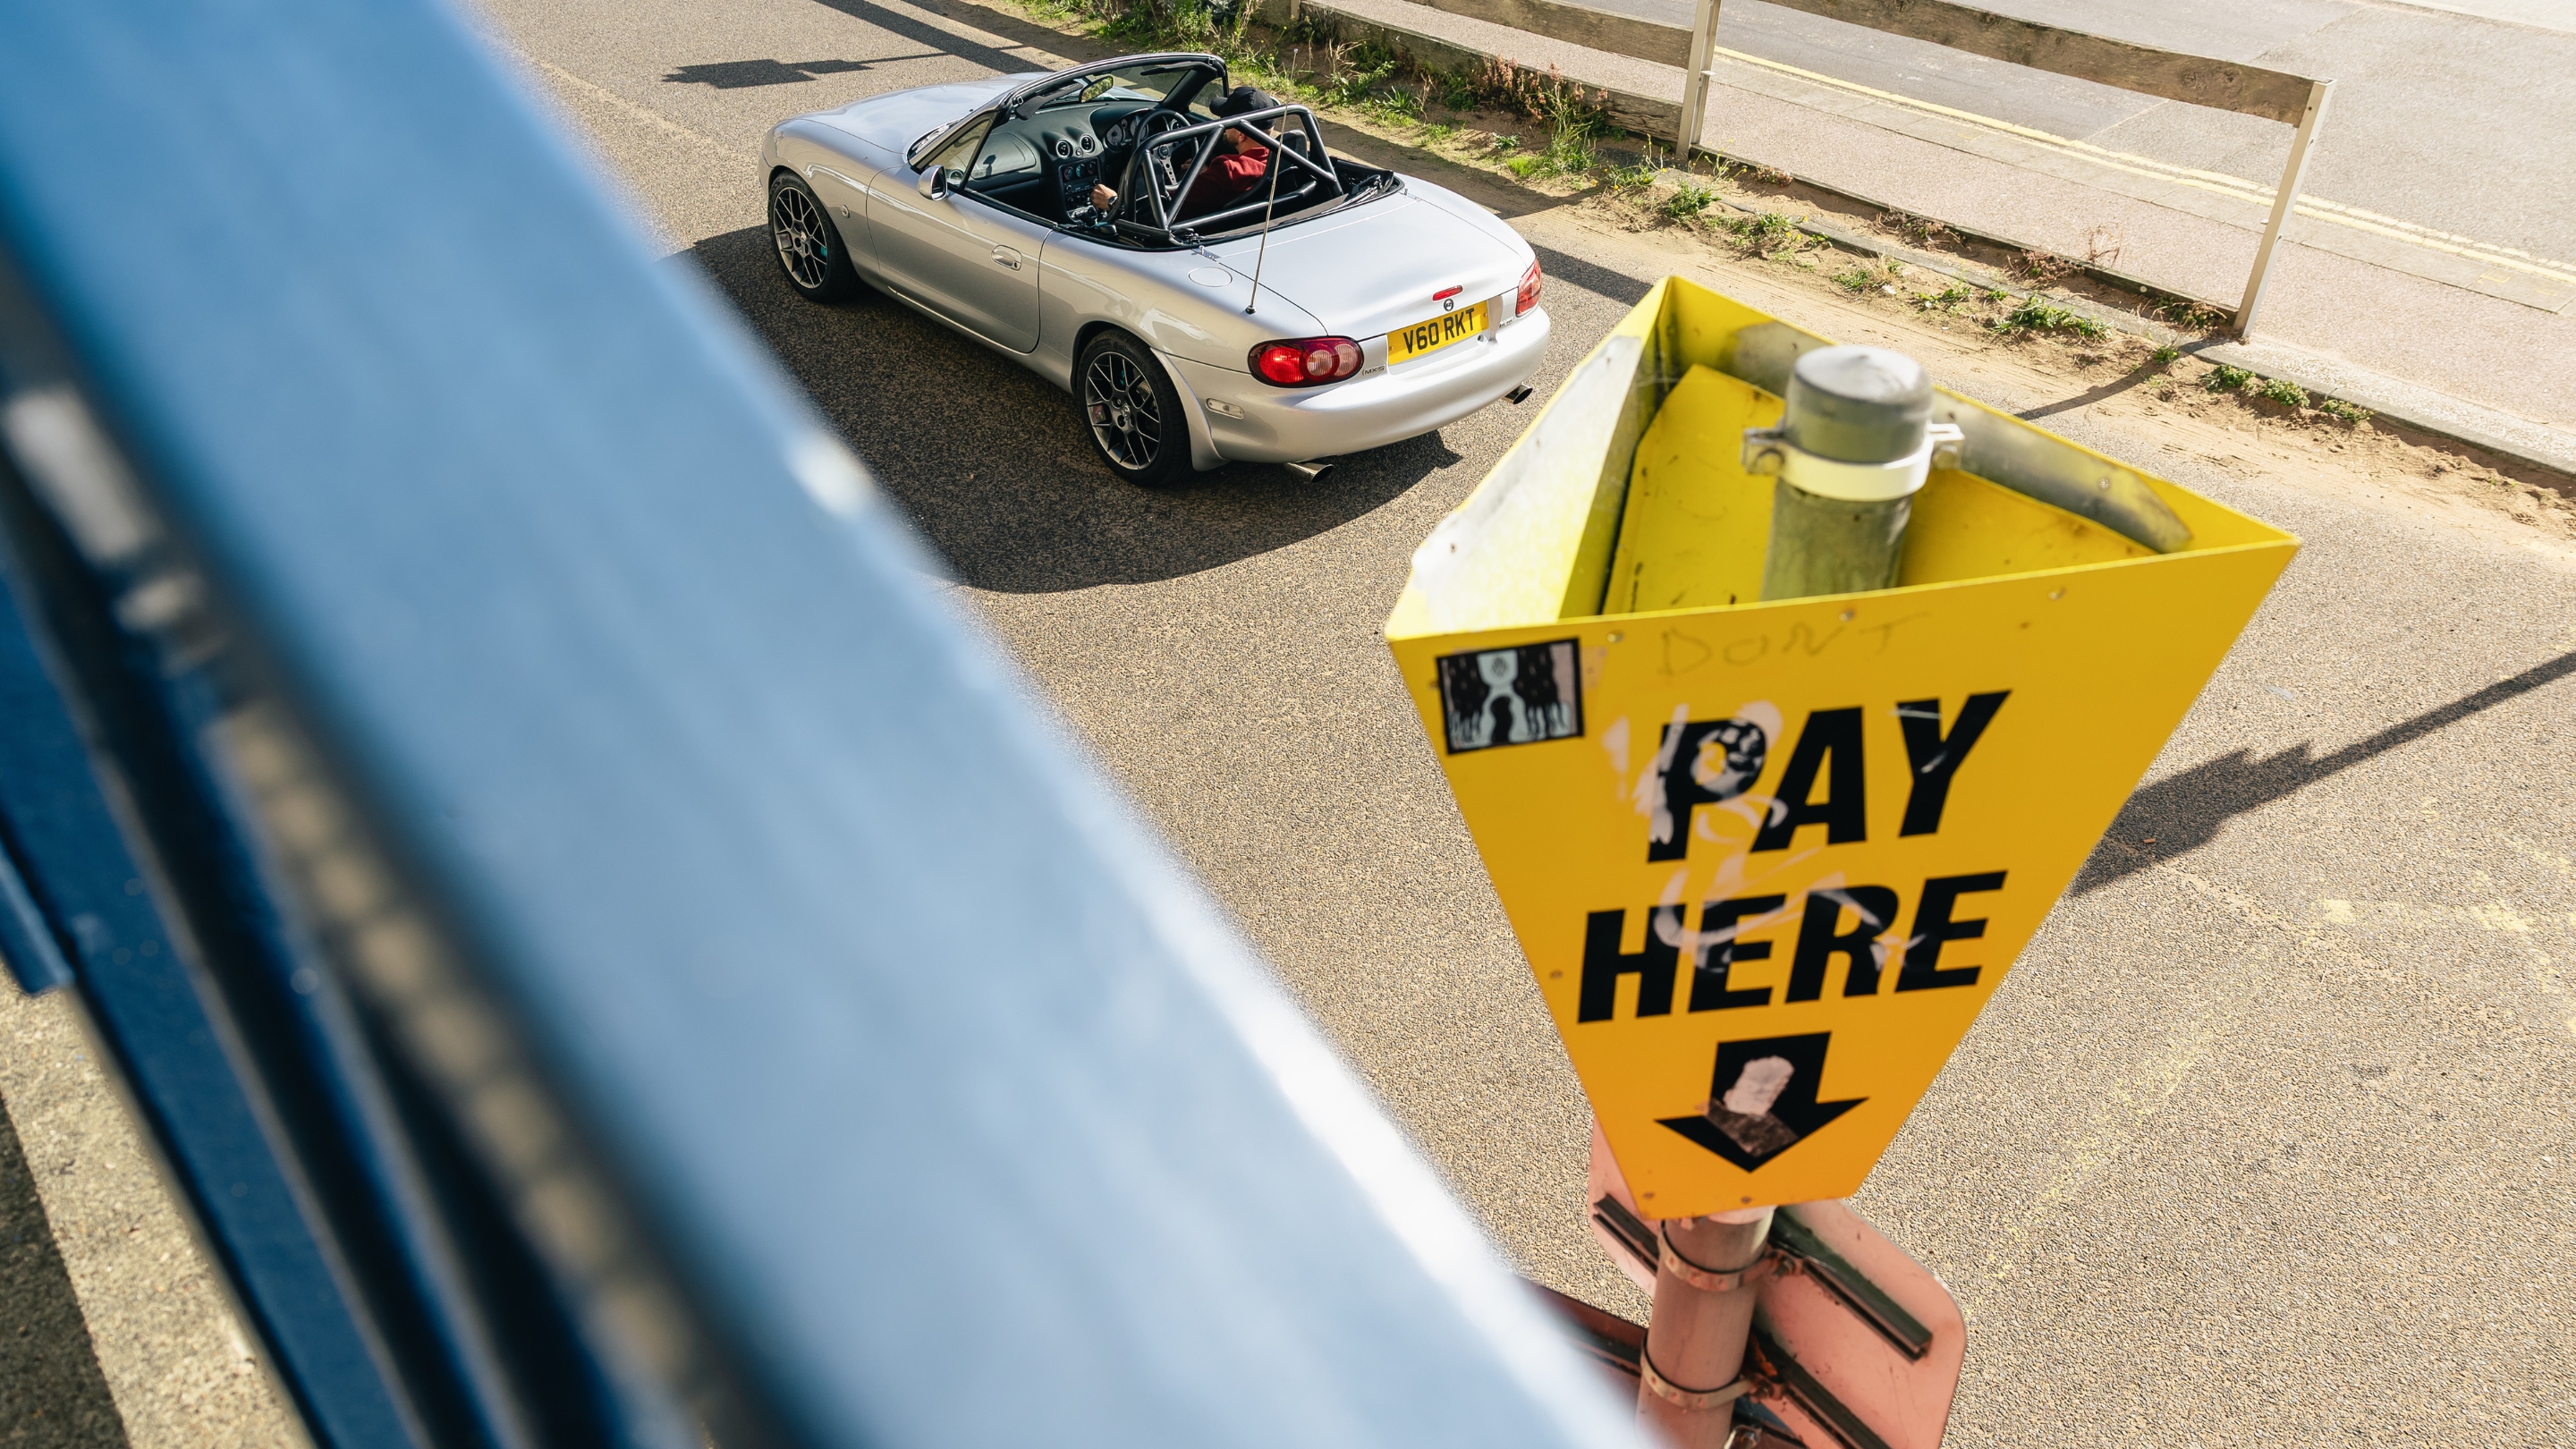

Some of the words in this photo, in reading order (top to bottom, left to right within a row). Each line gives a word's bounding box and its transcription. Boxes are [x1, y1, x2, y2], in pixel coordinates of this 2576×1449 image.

[1402, 322, 1439, 354] V60
[1444, 308, 1475, 341] RKT
[1648, 689, 2012, 863] PAY
[1578, 870, 2008, 1023] HERE
